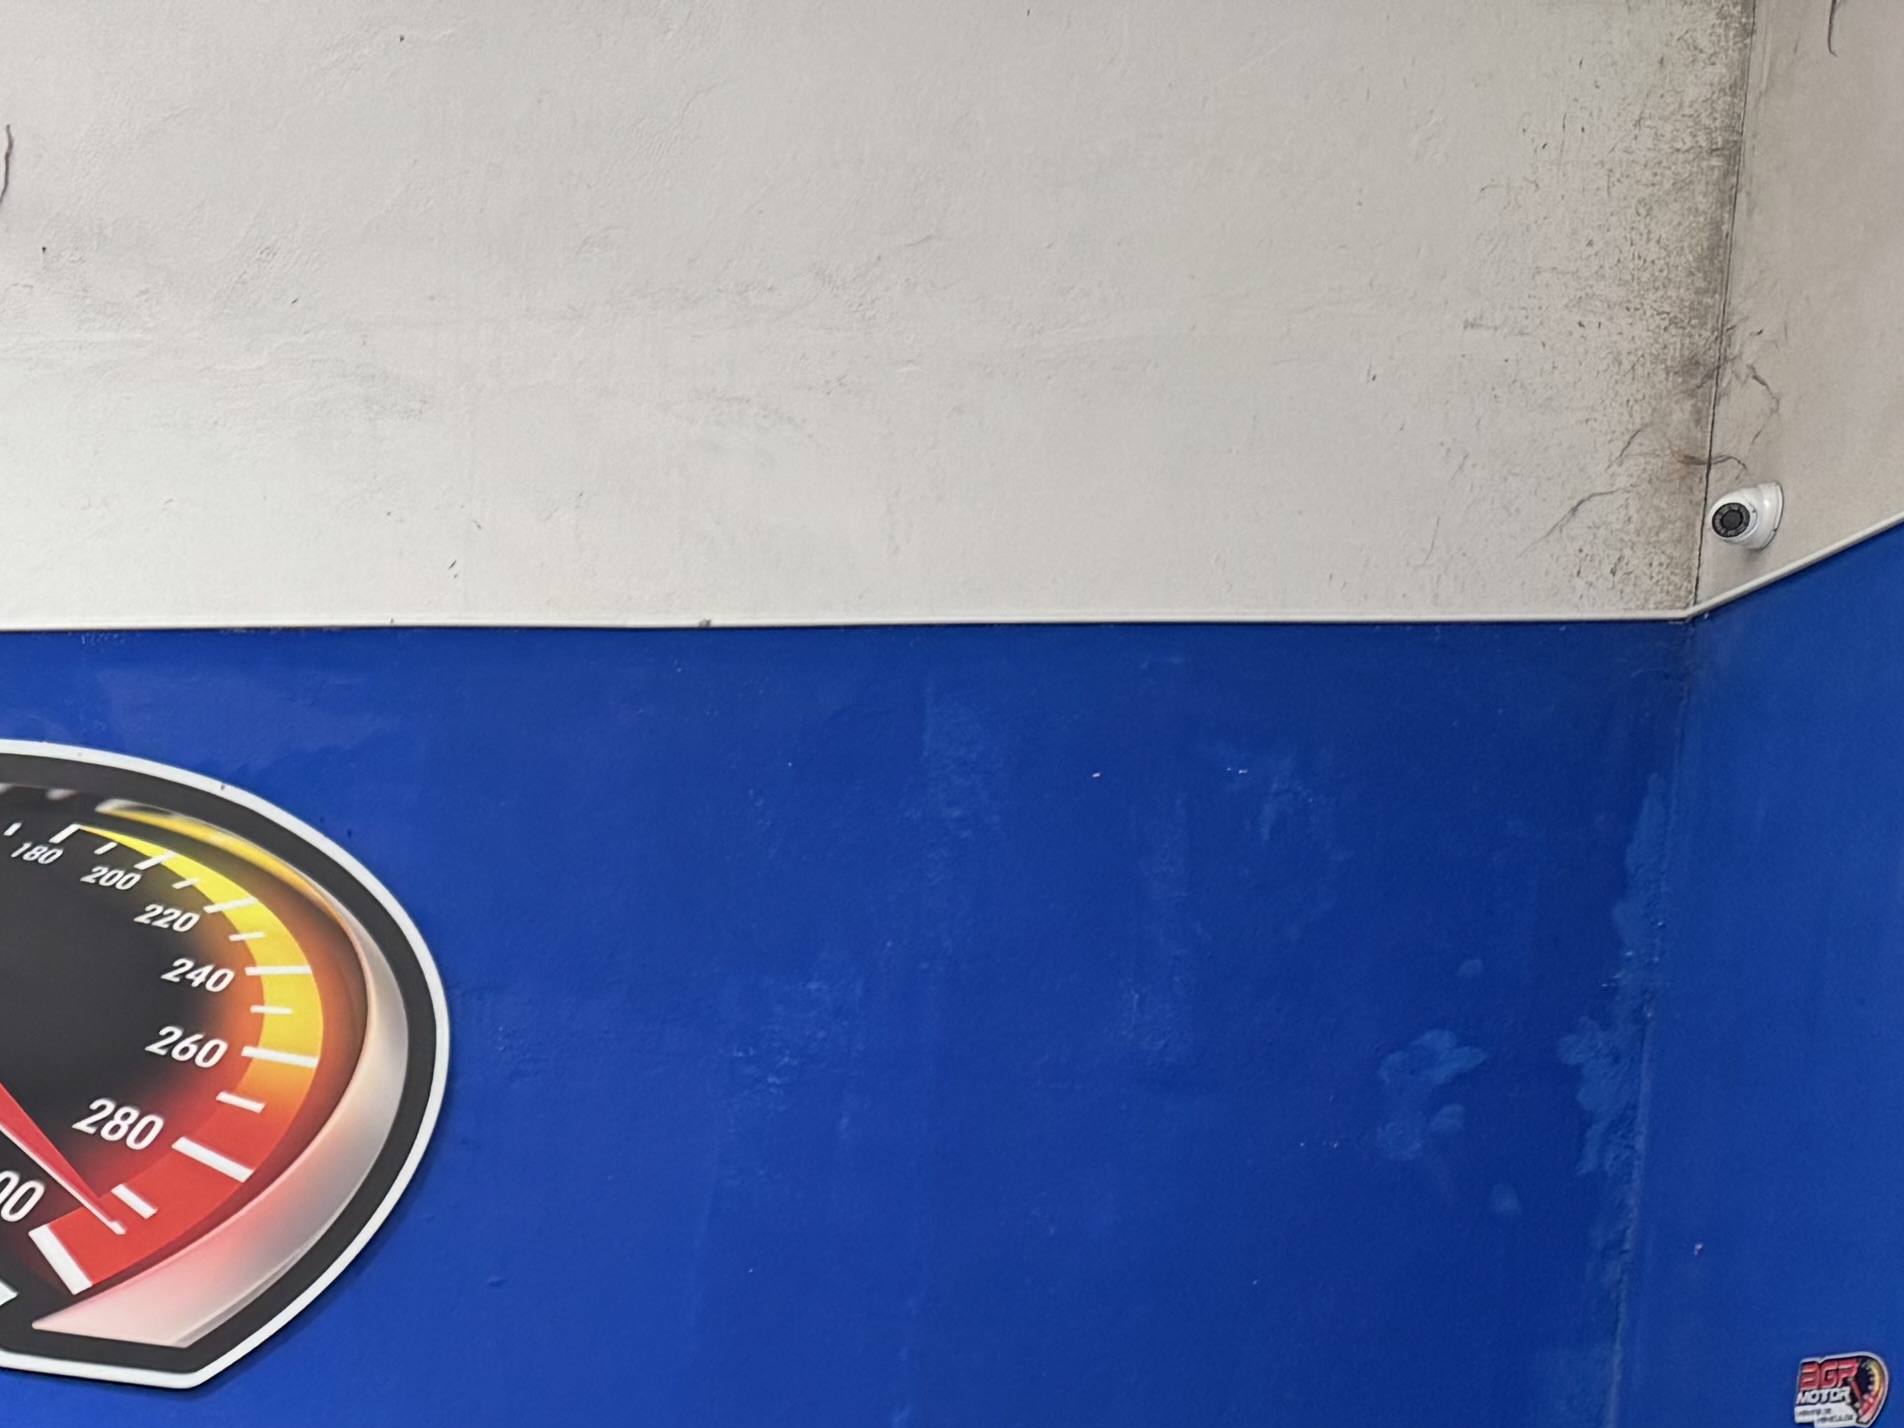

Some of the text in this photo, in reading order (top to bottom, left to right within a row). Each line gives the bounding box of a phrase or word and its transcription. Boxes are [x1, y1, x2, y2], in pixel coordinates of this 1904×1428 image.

[11, 836, 63, 865] 180
[81, 865, 142, 891] 200
[134, 903, 200, 933] 220
[160, 957, 235, 993] 240
[145, 1026, 228, 1069] 260
[72, 1097, 165, 1152] 280
